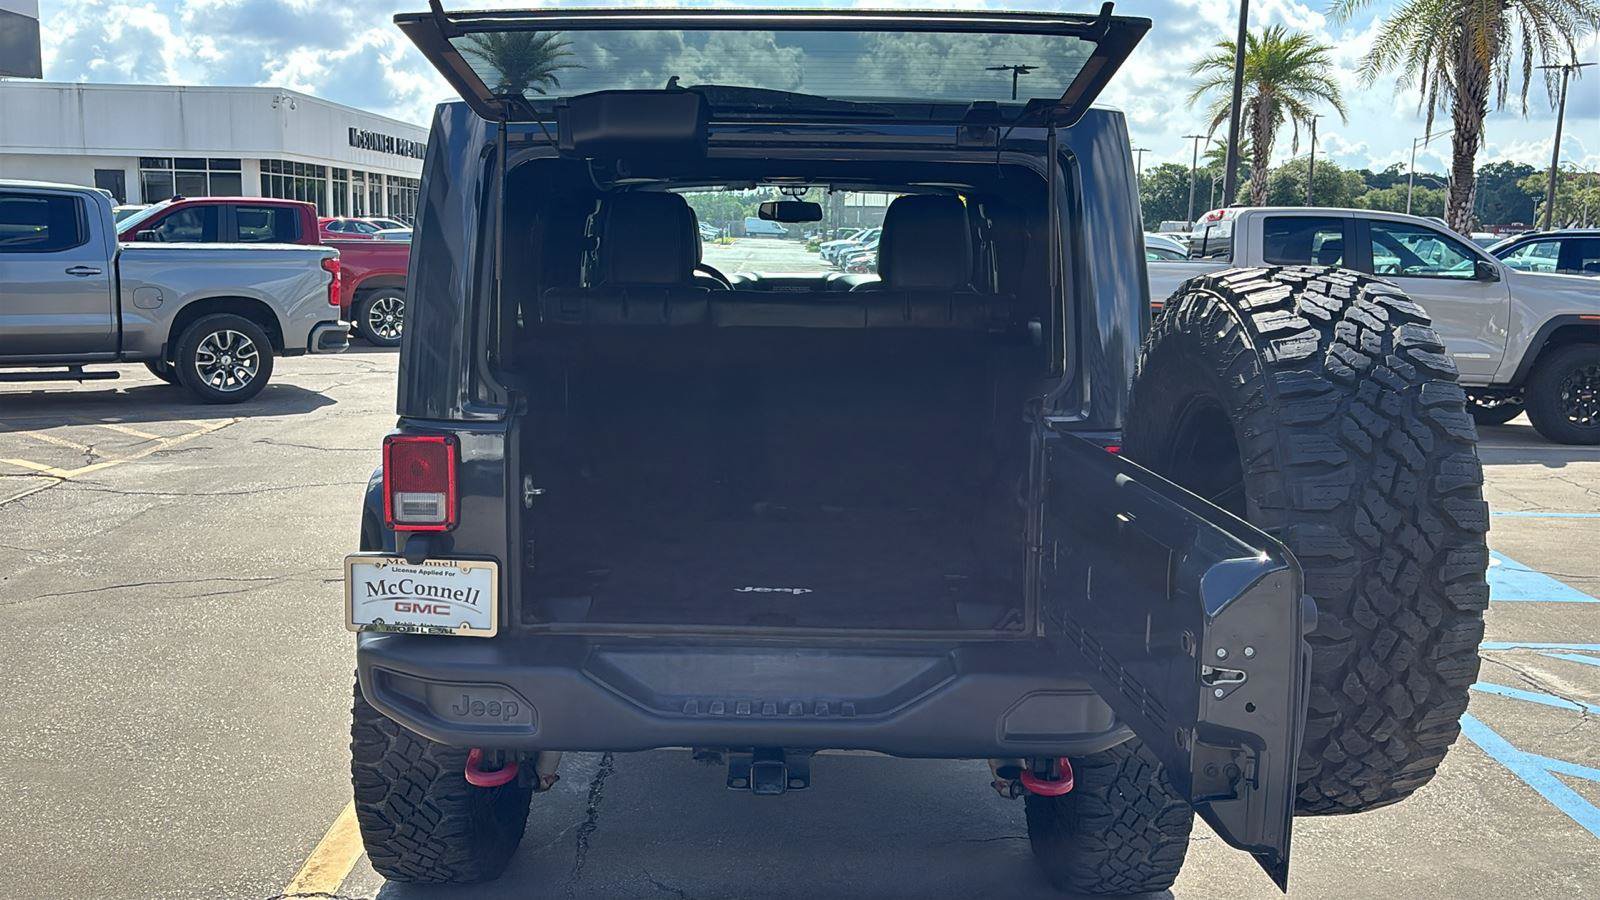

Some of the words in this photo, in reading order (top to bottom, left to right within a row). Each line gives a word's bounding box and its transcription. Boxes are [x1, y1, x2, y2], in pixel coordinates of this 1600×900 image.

[386, 558, 458, 568] Mcnnell
[365, 578, 481, 607] McConnell
[394, 602, 451, 616] GMC
[452, 694, 519, 721] Jeep
